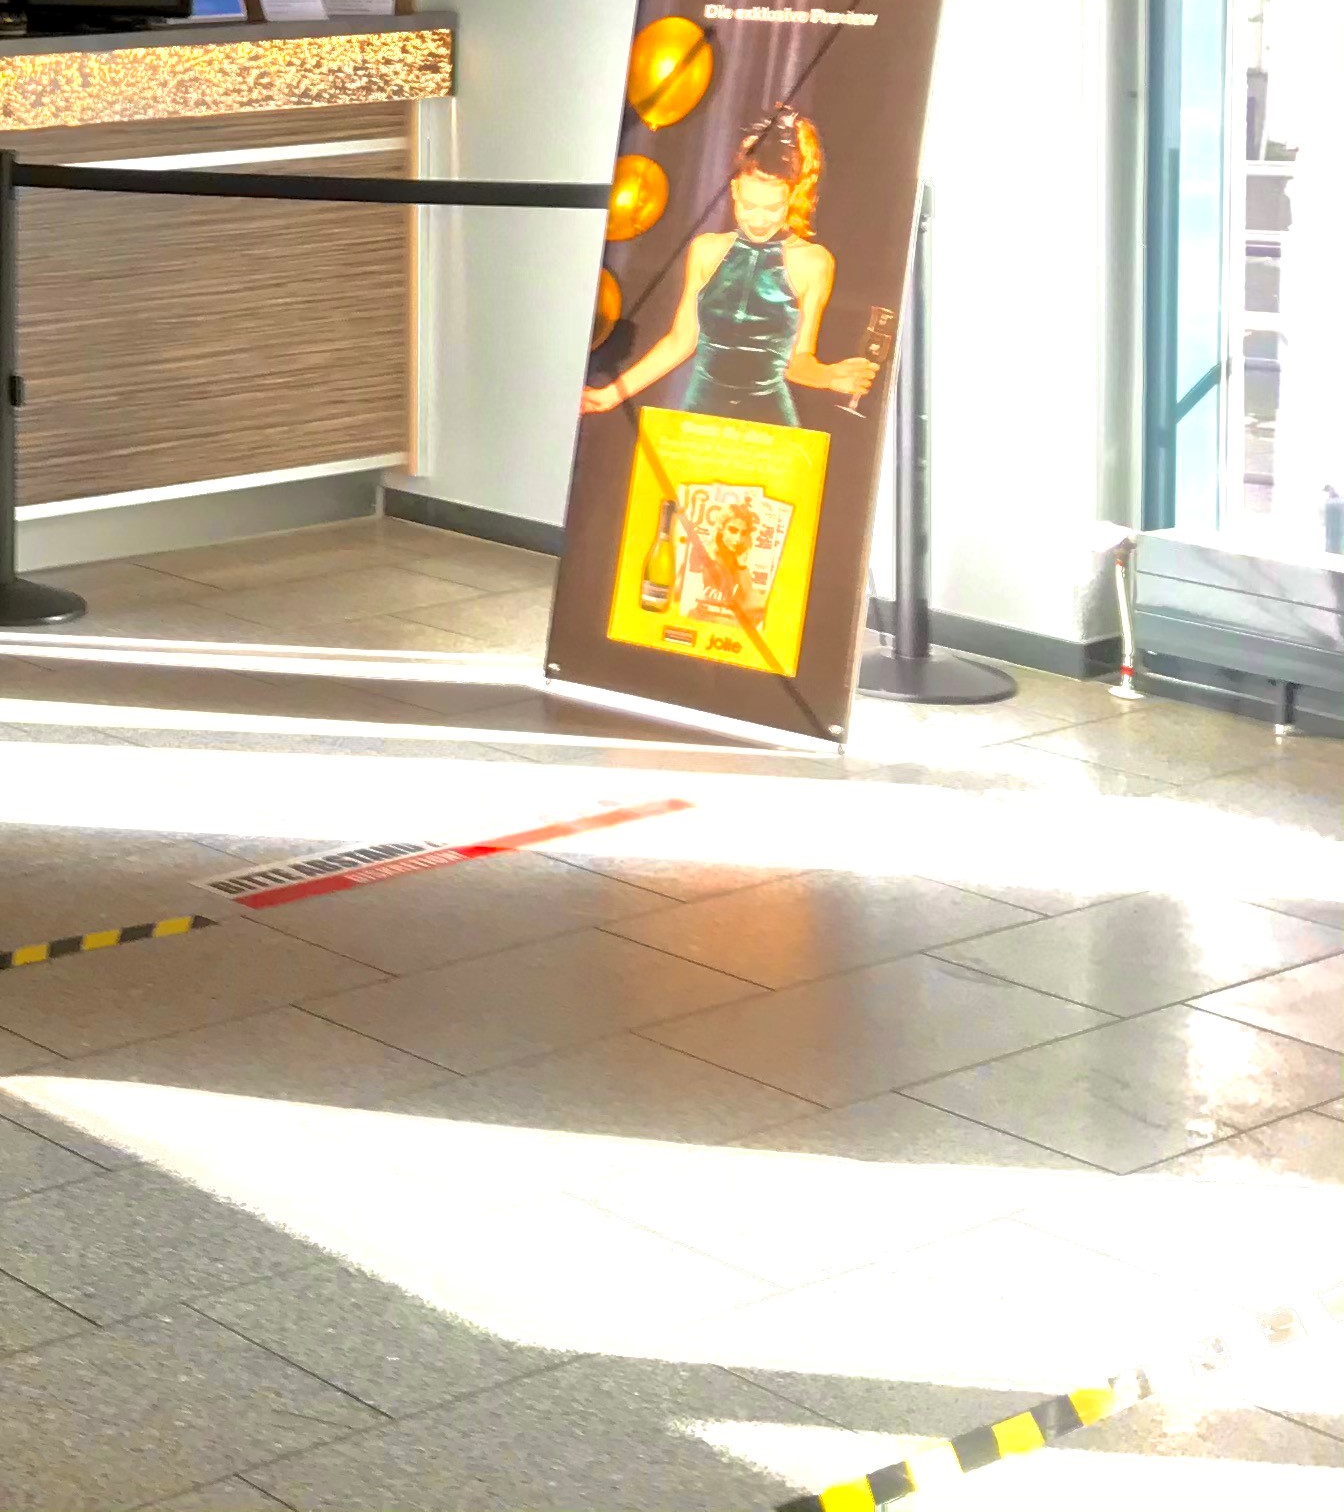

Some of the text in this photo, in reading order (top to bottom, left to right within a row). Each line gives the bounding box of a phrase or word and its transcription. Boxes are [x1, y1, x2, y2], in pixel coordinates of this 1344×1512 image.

[704, 4, 879, 26] Die exklusive Preview
[209, 842, 425, 895] BITTE ABSTAND
